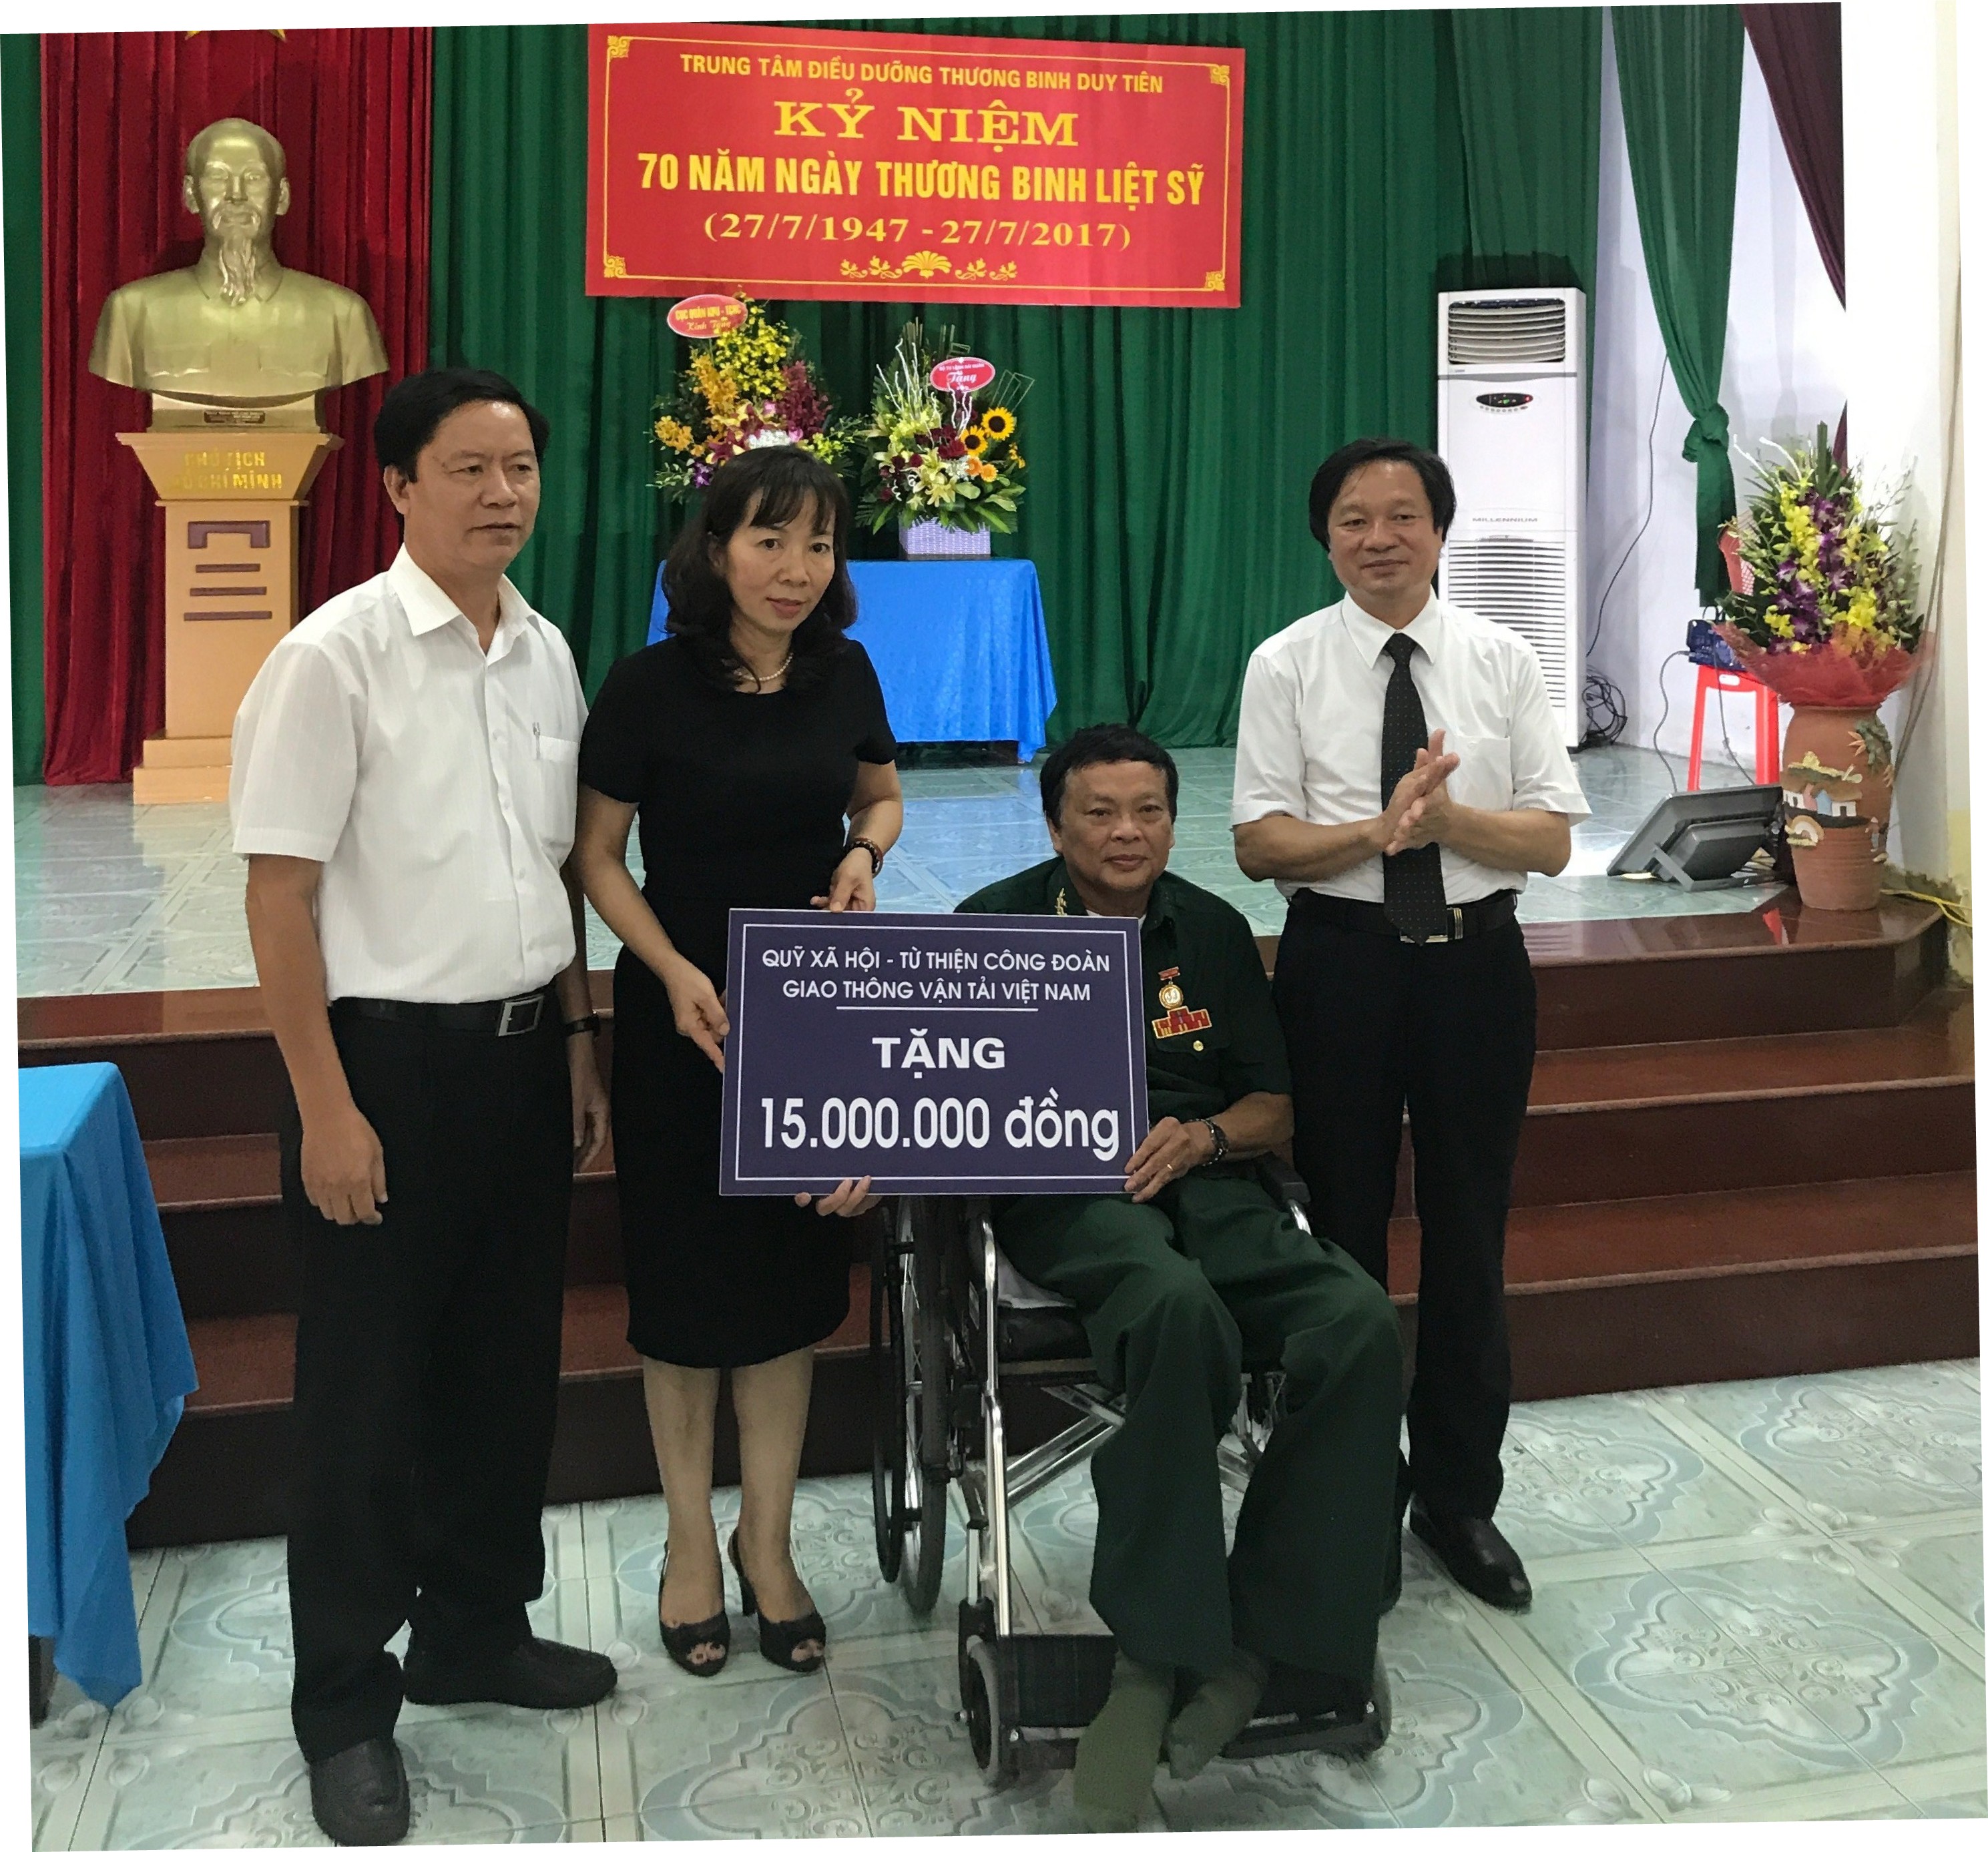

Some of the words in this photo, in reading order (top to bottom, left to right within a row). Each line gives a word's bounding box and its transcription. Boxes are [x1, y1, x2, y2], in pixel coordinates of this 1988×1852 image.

[680, 53, 751, 75] TRUNG
[758, 54, 803, 78] TÂM
[860, 60, 933, 84] DƯỠNG
[939, 66, 1021, 88] THƯƠNG
[1025, 70, 1071, 90] BINH
[1077, 73, 1117, 91] DUY
[1122, 70, 1163, 93] TIÊN
[774, 87, 875, 139] KỶ
[897, 99, 1079, 153] NIỆM
[638, 152, 679, 190] 70
[689, 147, 765, 193] NĂM
[775, 150, 863, 196] NGÀY
[875, 160, 1000, 201] THƯƠNG
[1011, 166, 1087, 203] BINH
[1095, 161, 1158, 212] LIỆT
[1166, 163, 1204, 206] SỸ
[704, 212, 909, 244] (27/7/1947
[940, 218, 1132, 252] 27/7/2017)
[762, 945, 805, 967] QUỸ
[810, 946, 839, 968] XÃ
[845, 946, 880, 972] HỘI
[899, 946, 922, 969] TỪ
[926, 948, 977, 974] THIỆN
[983, 948, 1046, 971] CÔNG
[1051, 949, 1109, 972] ĐOÀN
[782, 980, 838, 998] GIAO
[842, 976, 914, 999] THÔNG
[919, 977, 961, 1004] VẬN
[967, 976, 995, 1000] TẢI
[1001, 978, 1039, 1004] VIỆT
[1045, 983, 1090, 1001] NAM
[872, 1028, 1005, 1079] TẶNG
[761, 1097, 990, 1149] 15.000.000
[1004, 1087, 1120, 1161] đồng
